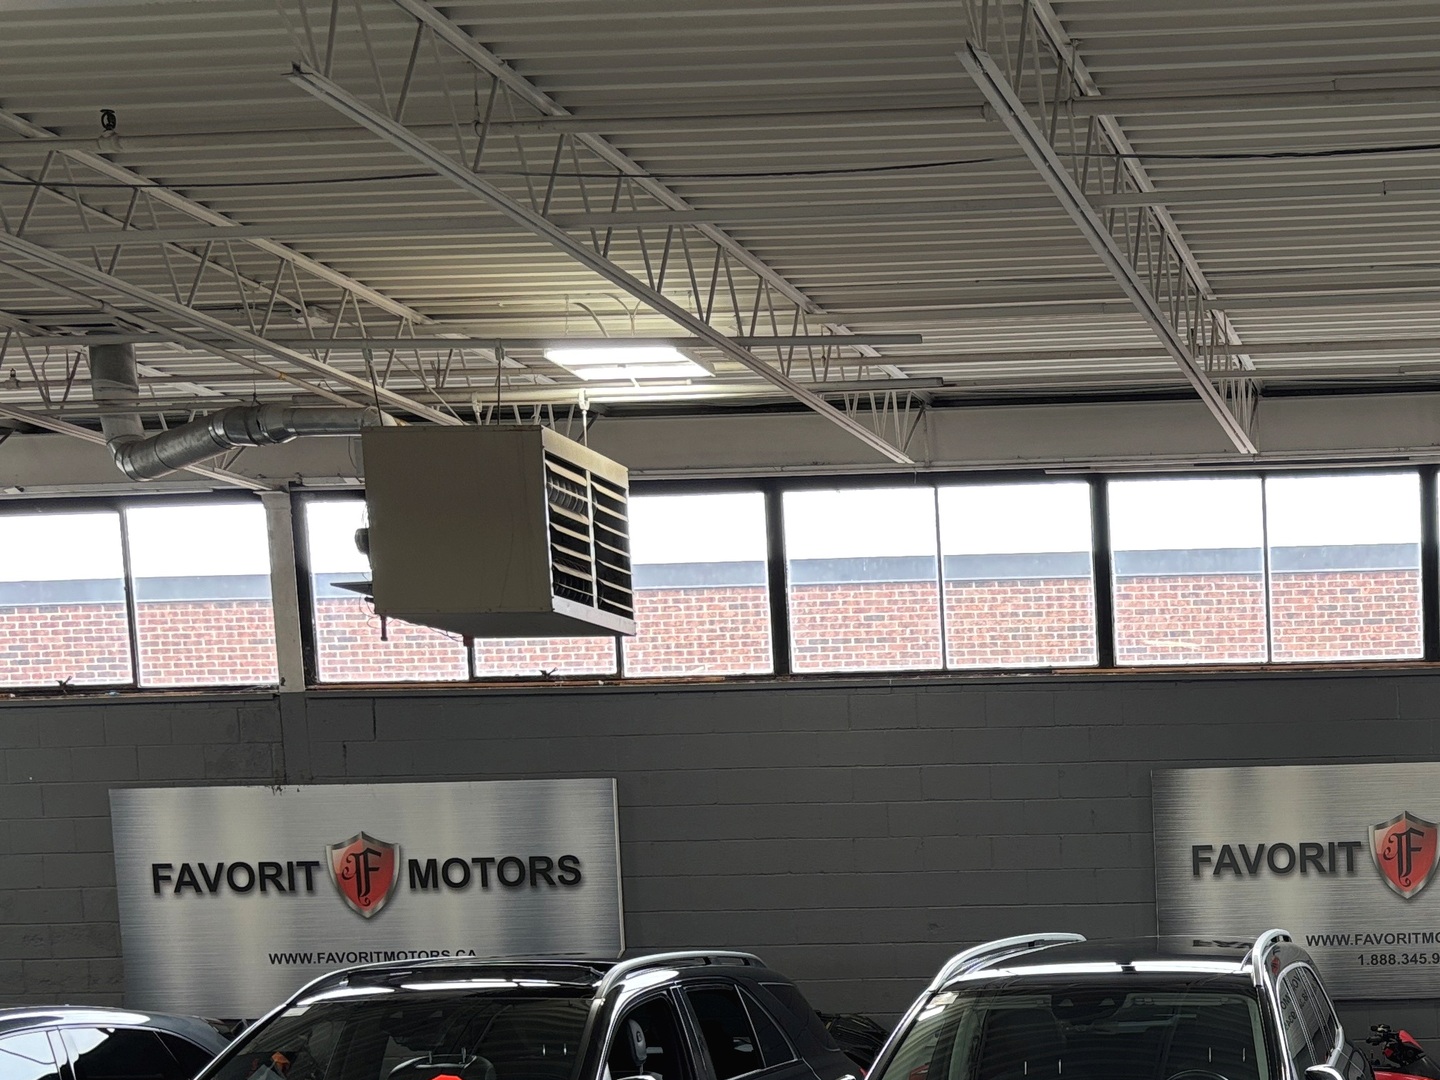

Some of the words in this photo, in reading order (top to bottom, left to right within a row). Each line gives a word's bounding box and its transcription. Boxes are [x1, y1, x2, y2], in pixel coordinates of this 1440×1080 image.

[152, 860, 321, 894] FAVORIT
[408, 855, 582, 890] MOTORS
[1191, 841, 1362, 876] FAVORIT
[268, 949, 477, 965] WWW.FAVORITMOTORSCA
